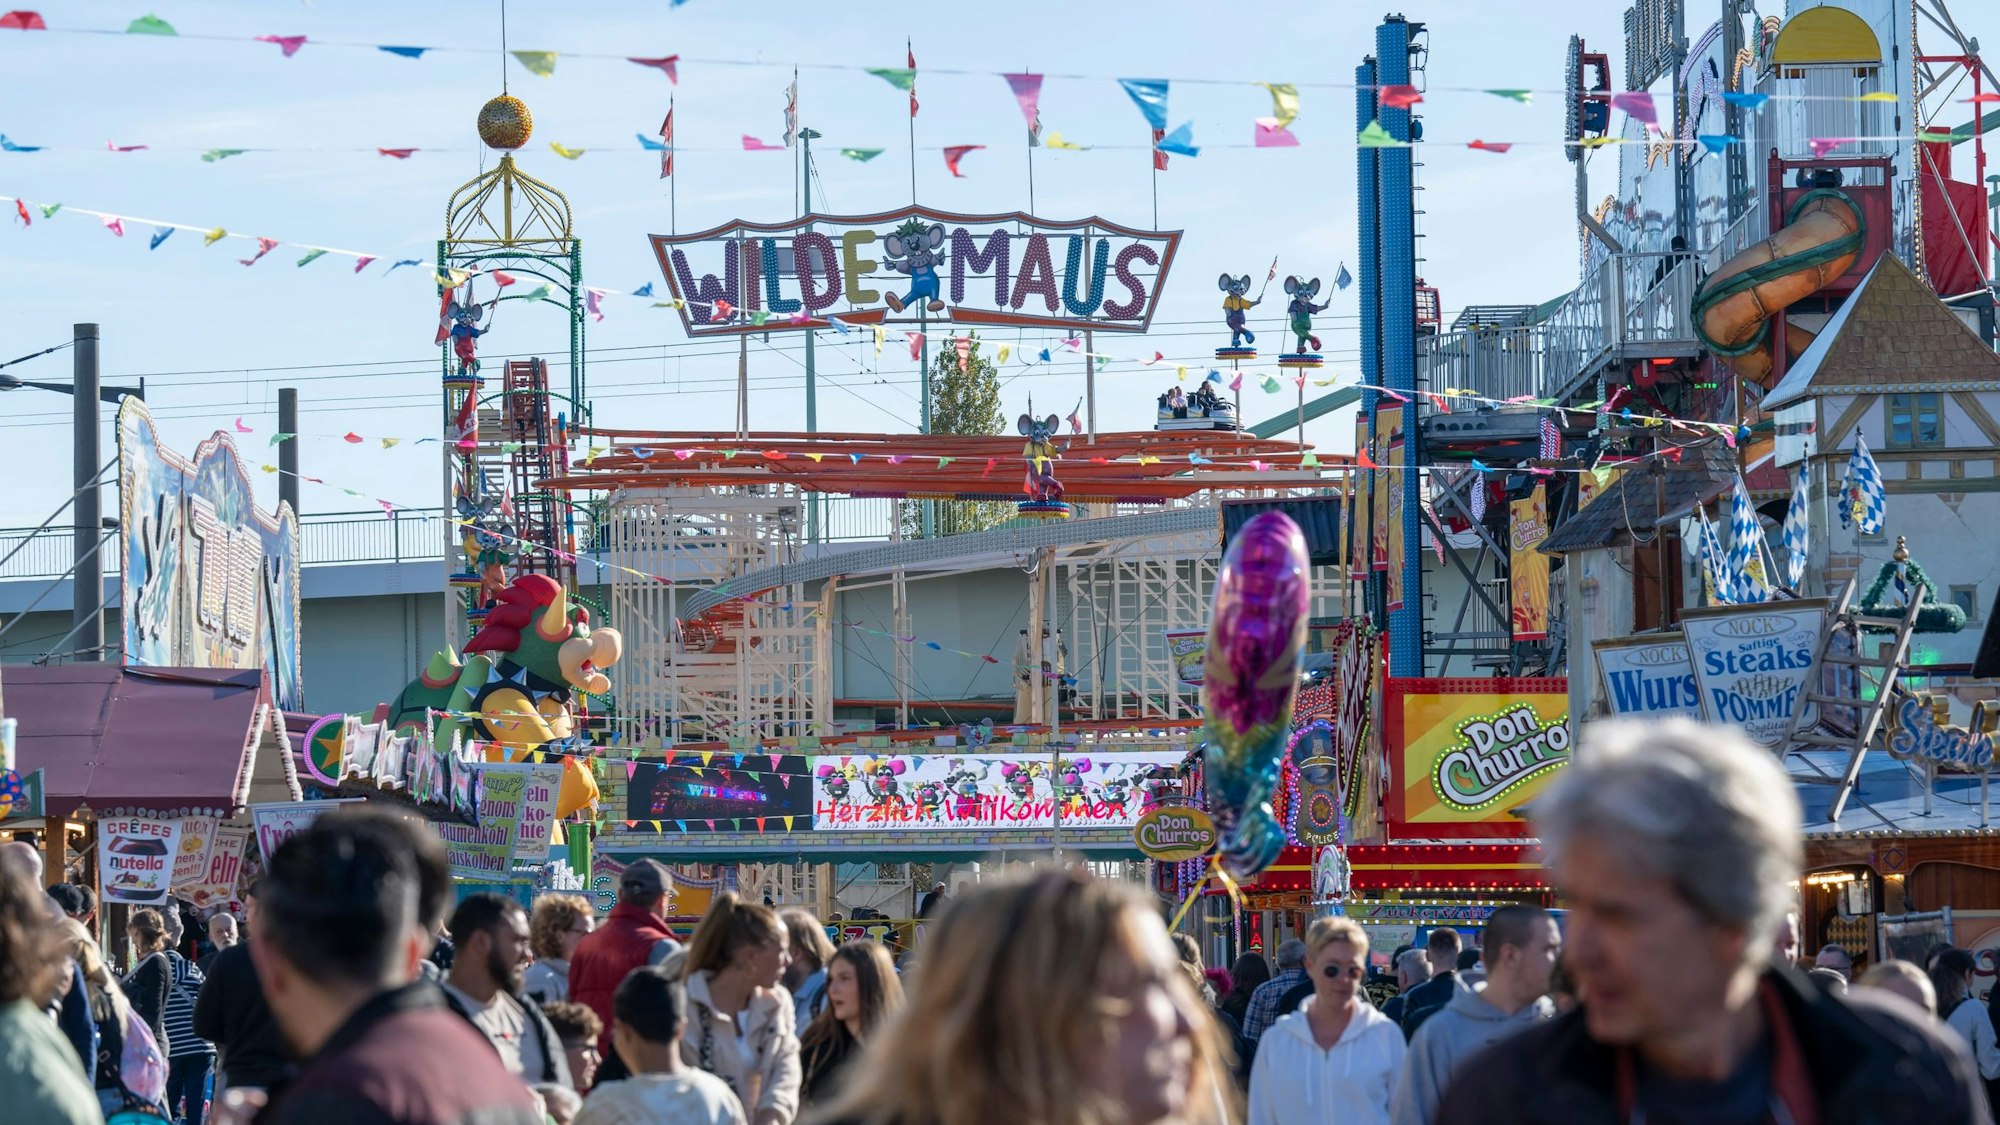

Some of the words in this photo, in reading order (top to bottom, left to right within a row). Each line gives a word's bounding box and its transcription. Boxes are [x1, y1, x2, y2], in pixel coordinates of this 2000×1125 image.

[671, 229, 880, 325] WILDE
[951, 228, 1159, 320] MAUS
[1738, 637, 1780, 653] Saftige
[1705, 645, 1812, 676] Steaks
[1463, 708, 1538, 755] Don
[1440, 719, 1568, 805] Churro
[816, 794, 933, 823] Herzlich
[945, 793, 1126, 822] Willkommen
[107, 818, 172, 838] CRÊPES
[439, 822, 509, 845] Blumenkohl
[1159, 815, 1189, 829] Don
[1141, 822, 1210, 848] Churros
[1306, 830, 1339, 844] POLICE
[109, 855, 163, 870] nutella
